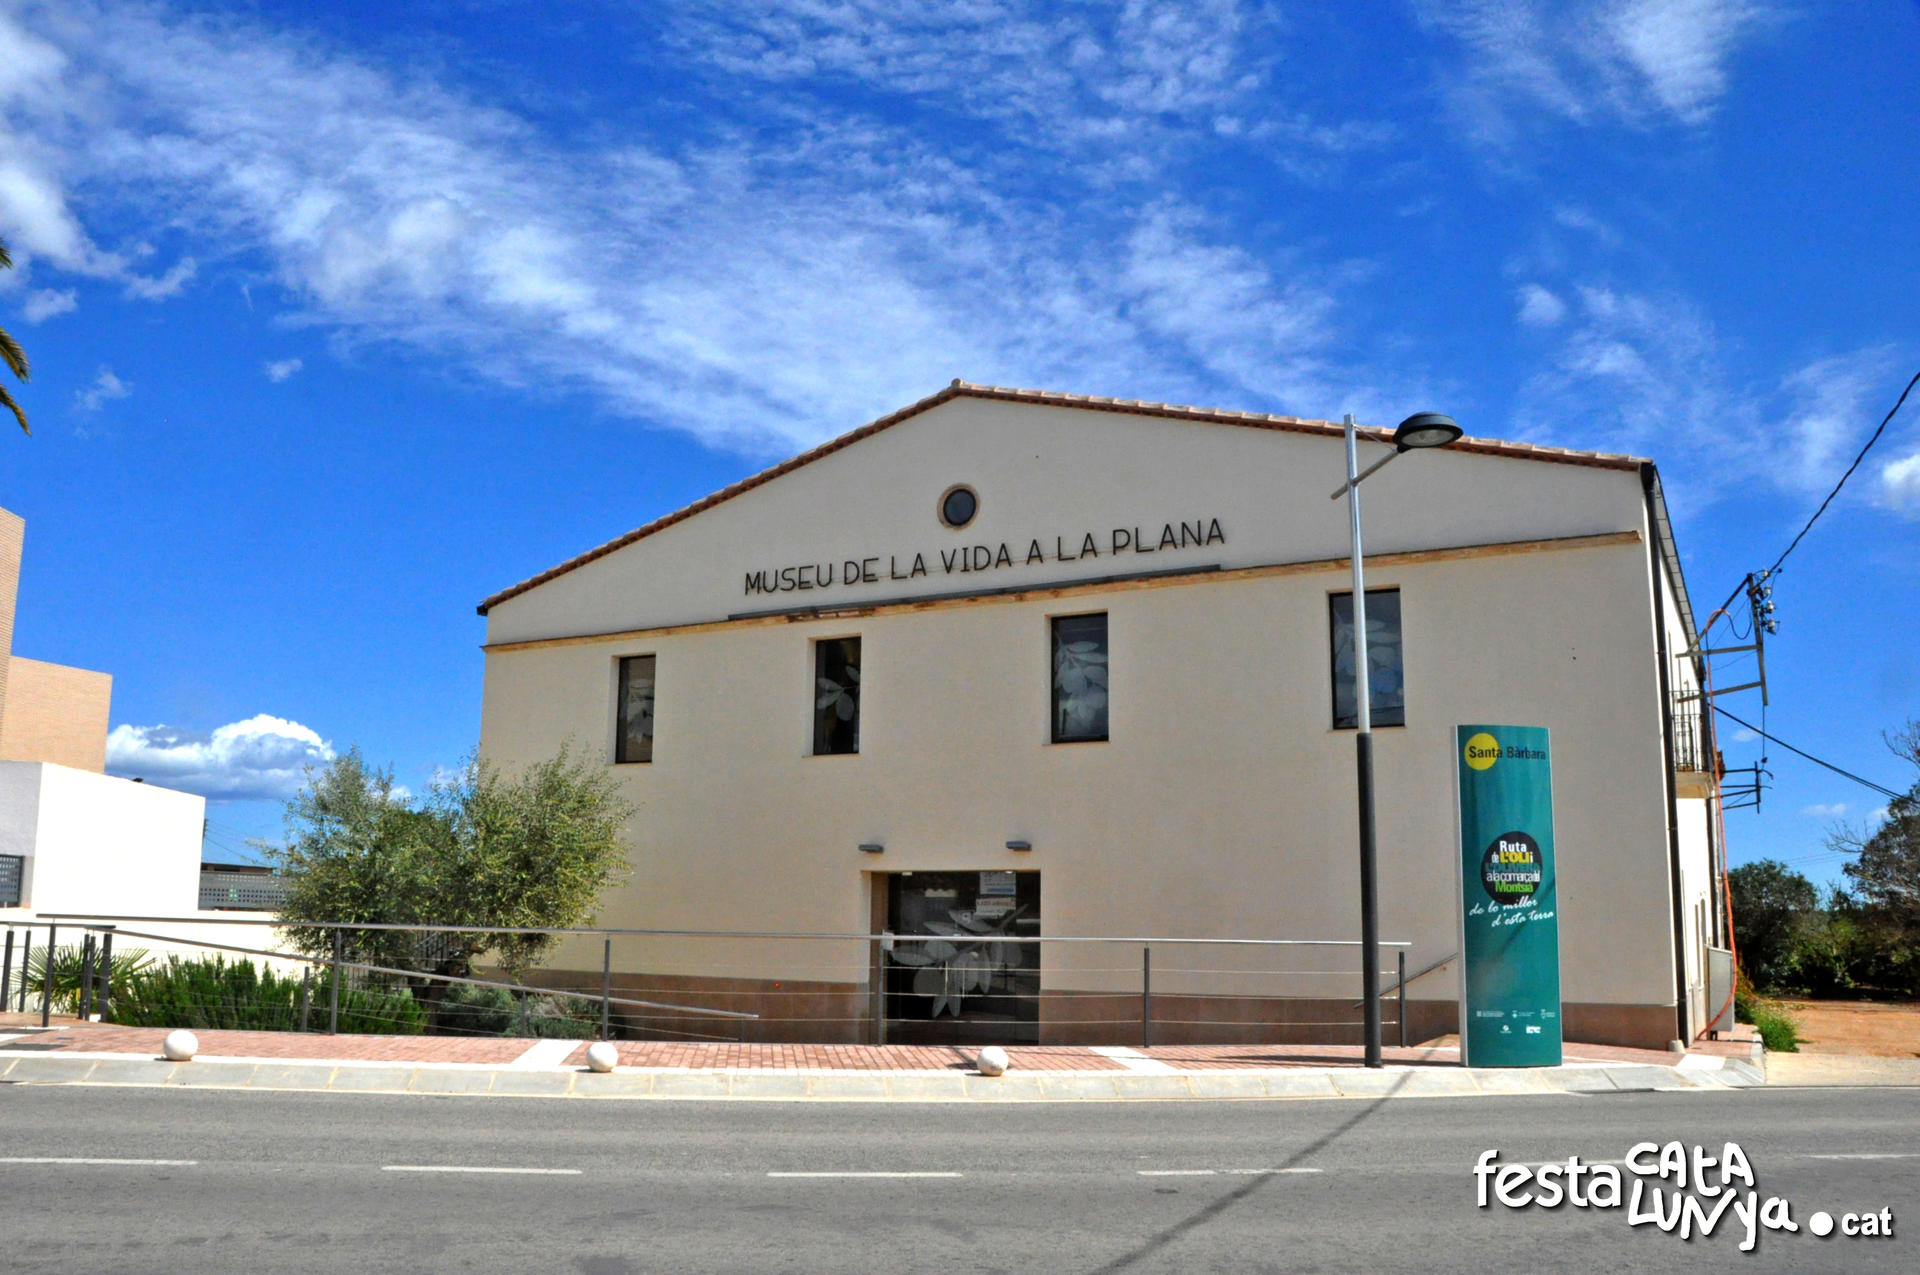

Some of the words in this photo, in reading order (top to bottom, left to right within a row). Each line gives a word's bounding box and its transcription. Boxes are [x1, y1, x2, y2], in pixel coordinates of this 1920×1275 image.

[745, 562, 834, 596] MUSEU
[843, 557, 880, 586] DE
[891, 552, 927, 581] LA
[941, 542, 1013, 575] VIDA
[1026, 538, 1044, 564] A
[1057, 531, 1099, 563] LA
[1112, 517, 1226, 556] PLANA
[1469, 746, 1502, 759] Santa
[1500, 840, 1527, 852] Ruta
[1488, 900, 1499, 913] lo
[1503, 895, 1537, 910] millor
[1529, 910, 1554, 920] terra
